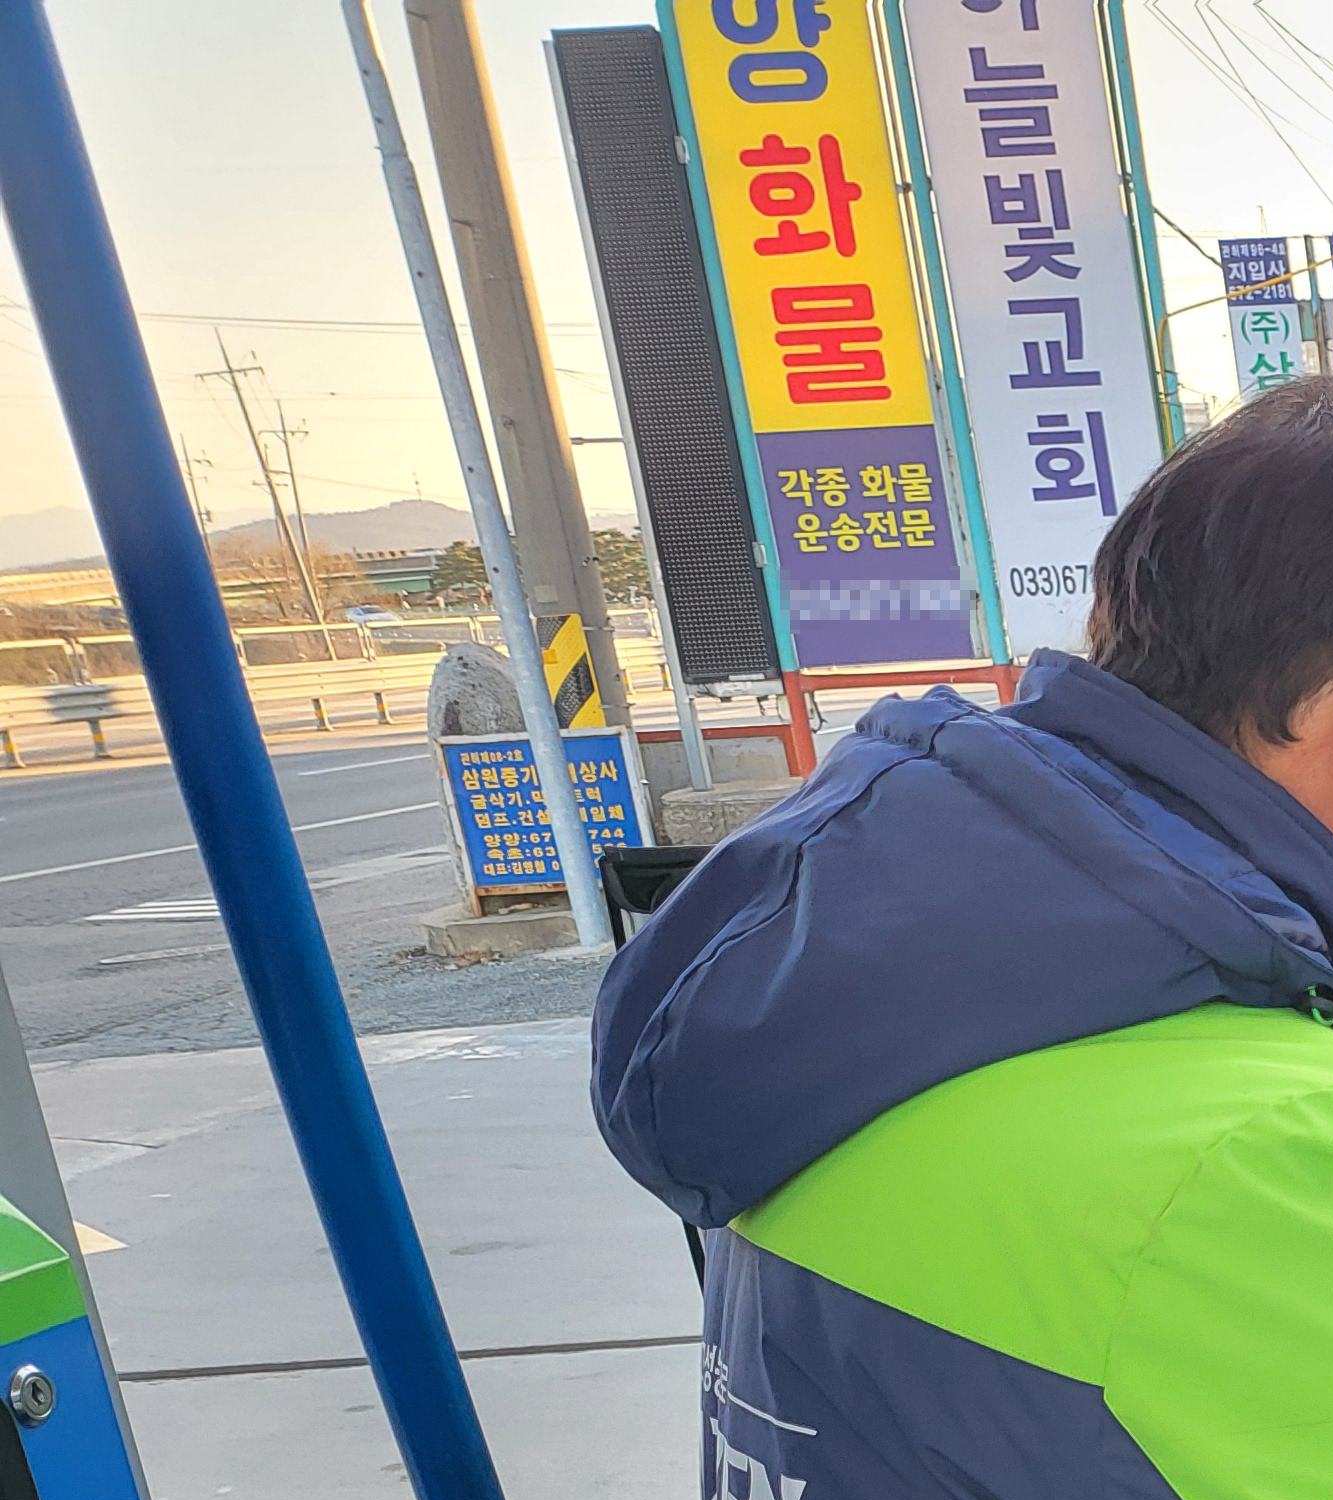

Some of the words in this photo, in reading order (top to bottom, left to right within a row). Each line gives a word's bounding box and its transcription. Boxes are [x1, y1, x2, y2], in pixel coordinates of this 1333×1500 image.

[777, 468, 851, 508] 각종
[862, 463, 933, 505] 화물
[792, 508, 937, 553] 운송전문
